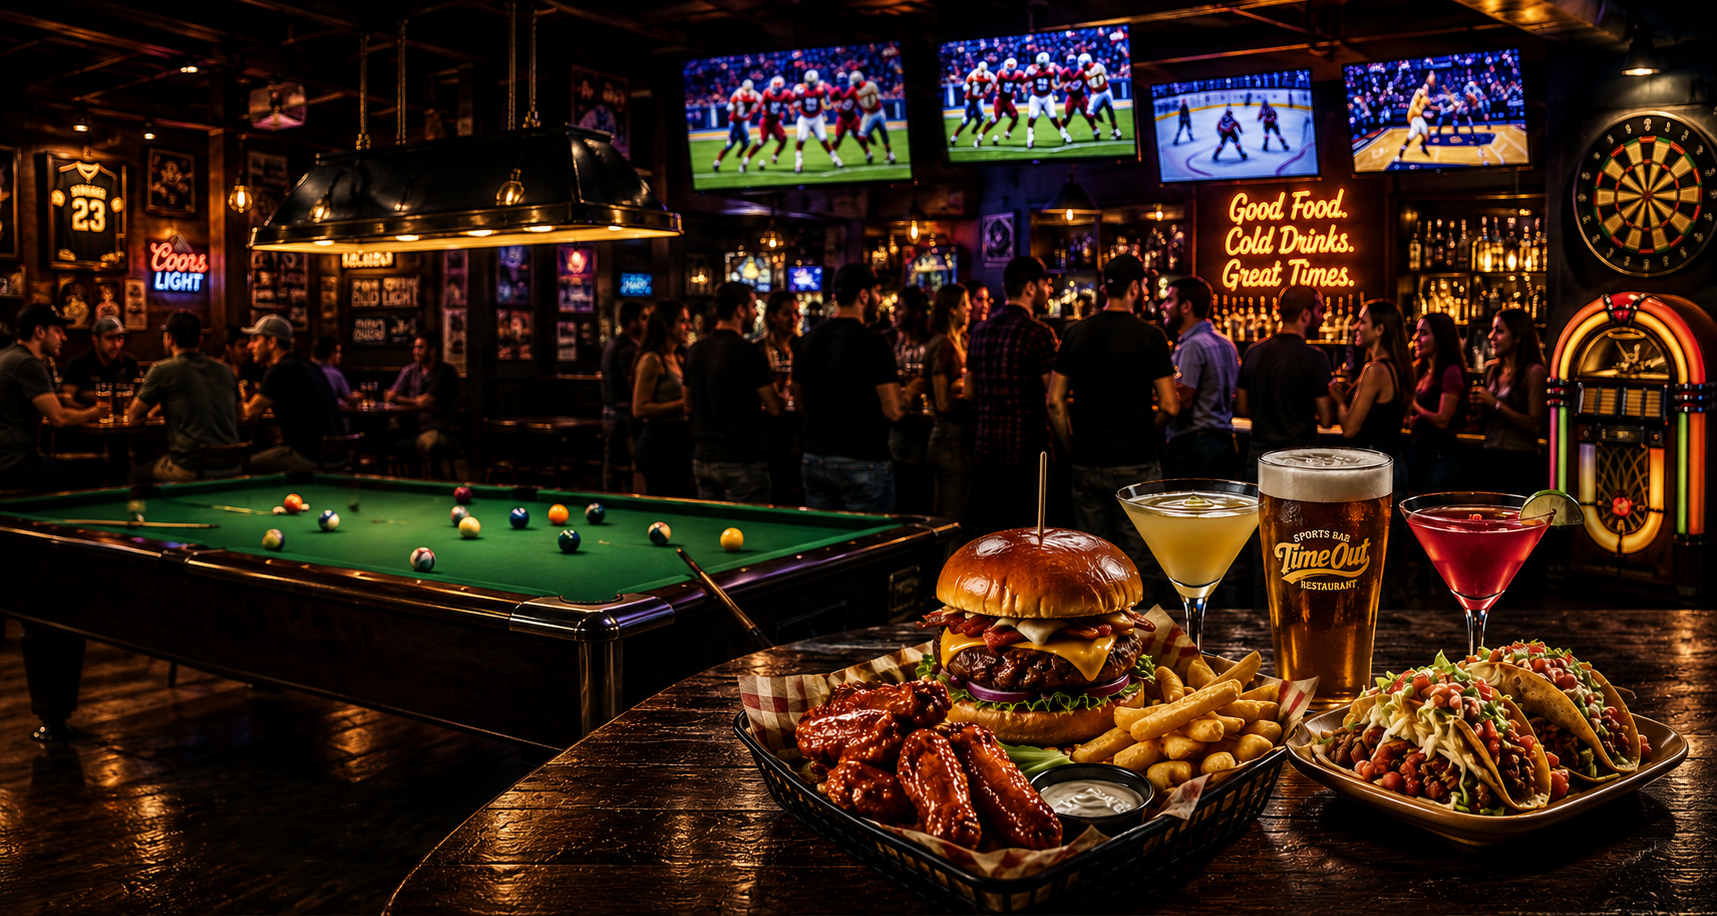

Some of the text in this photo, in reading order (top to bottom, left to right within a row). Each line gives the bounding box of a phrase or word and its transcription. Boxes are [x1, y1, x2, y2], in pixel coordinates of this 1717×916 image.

[72, 197, 106, 232] 23
[1229, 188, 1348, 226] Good Food.
[1225, 224, 1355, 256] Cold Drinks.
[150, 242, 209, 273] Coors
[154, 271, 204, 292] LIGHT
[1222, 258, 1355, 291] Great Times.
[1293, 529, 1330, 543] SPORTS
